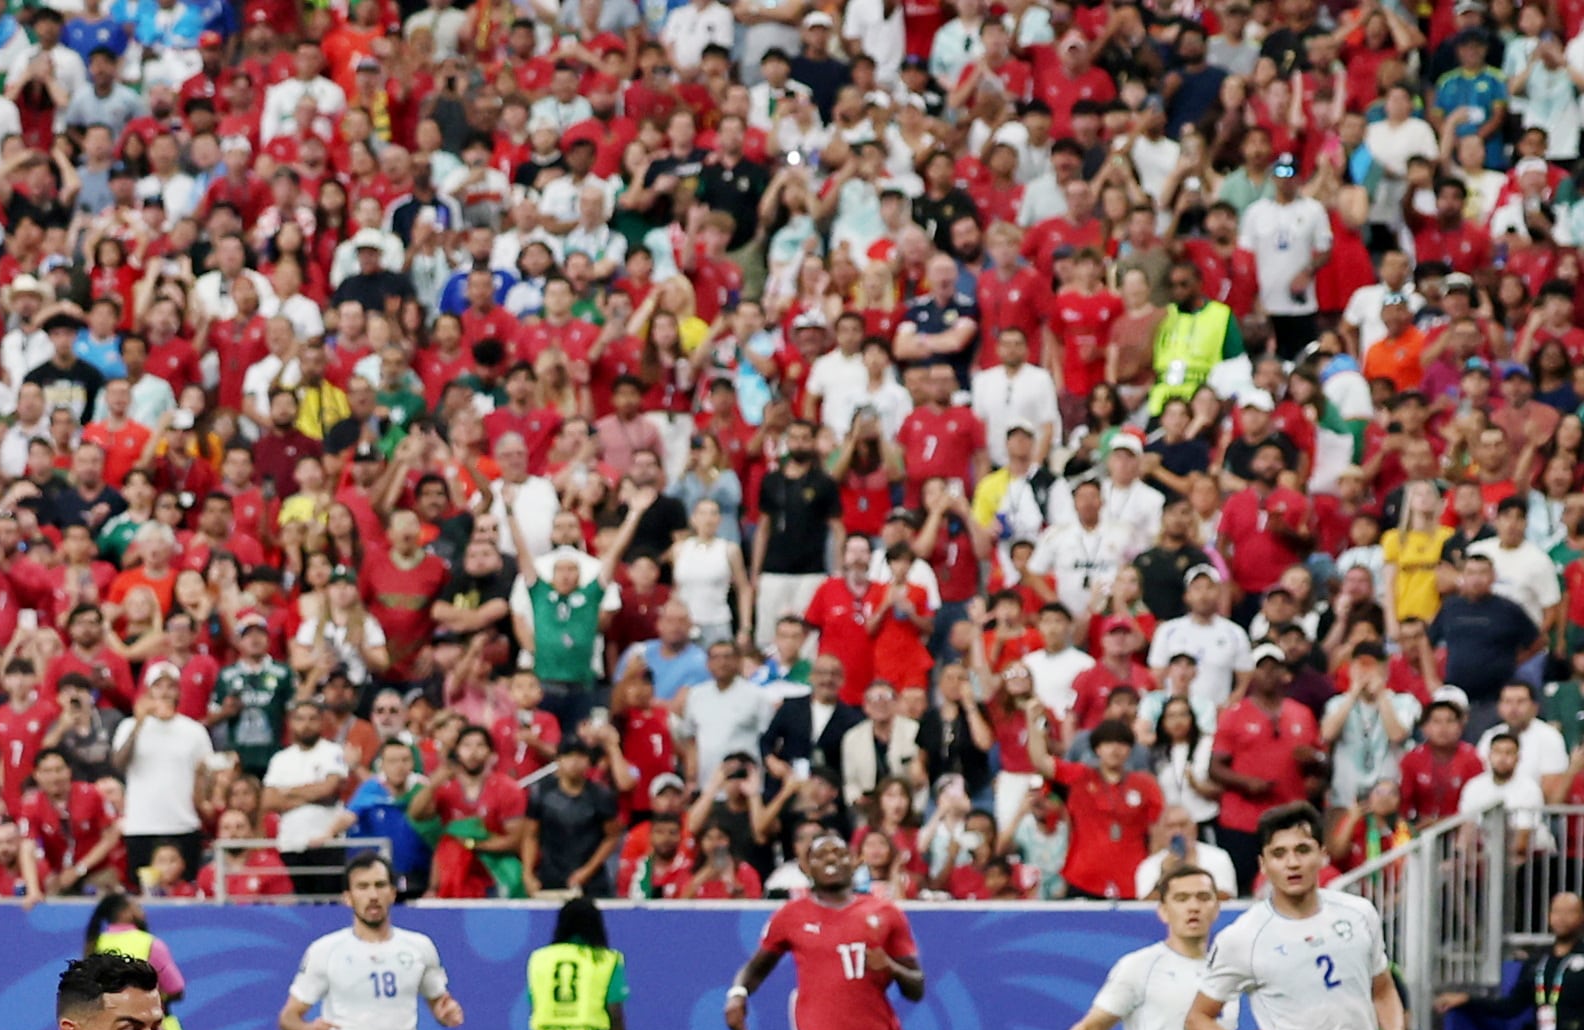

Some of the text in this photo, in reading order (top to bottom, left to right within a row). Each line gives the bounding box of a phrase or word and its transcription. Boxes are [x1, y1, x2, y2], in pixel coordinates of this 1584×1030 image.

[837, 942, 867, 980] 17
[1315, 953, 1342, 990] 2
[369, 970, 398, 998] 18
